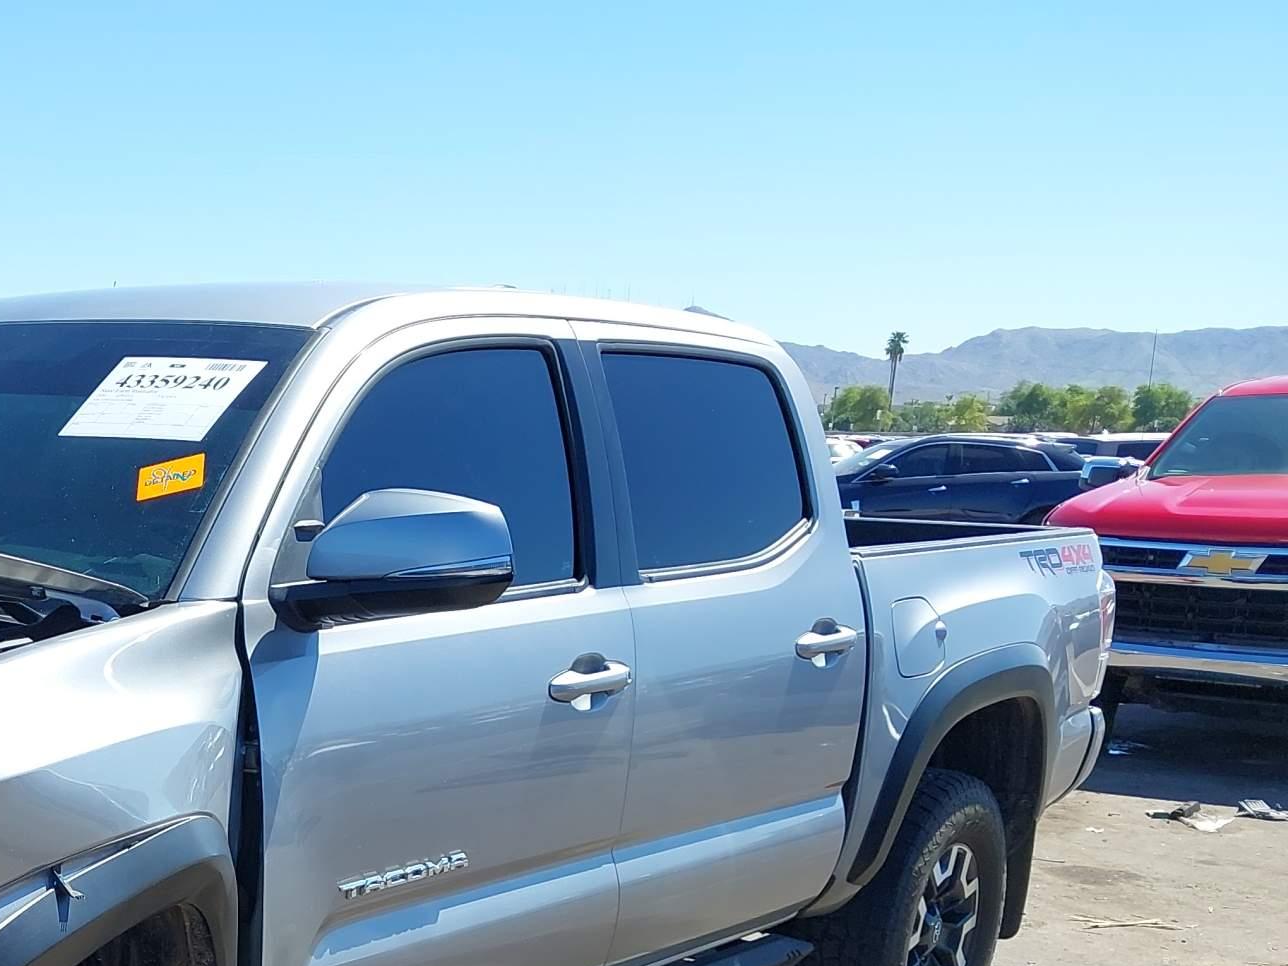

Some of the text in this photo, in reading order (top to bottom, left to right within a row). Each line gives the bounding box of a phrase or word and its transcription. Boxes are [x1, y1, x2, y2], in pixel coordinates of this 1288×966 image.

[115, 374, 231, 391] 43359240
[1019, 548, 1063, 577] TRD
[338, 851, 470, 900] TACOMA
